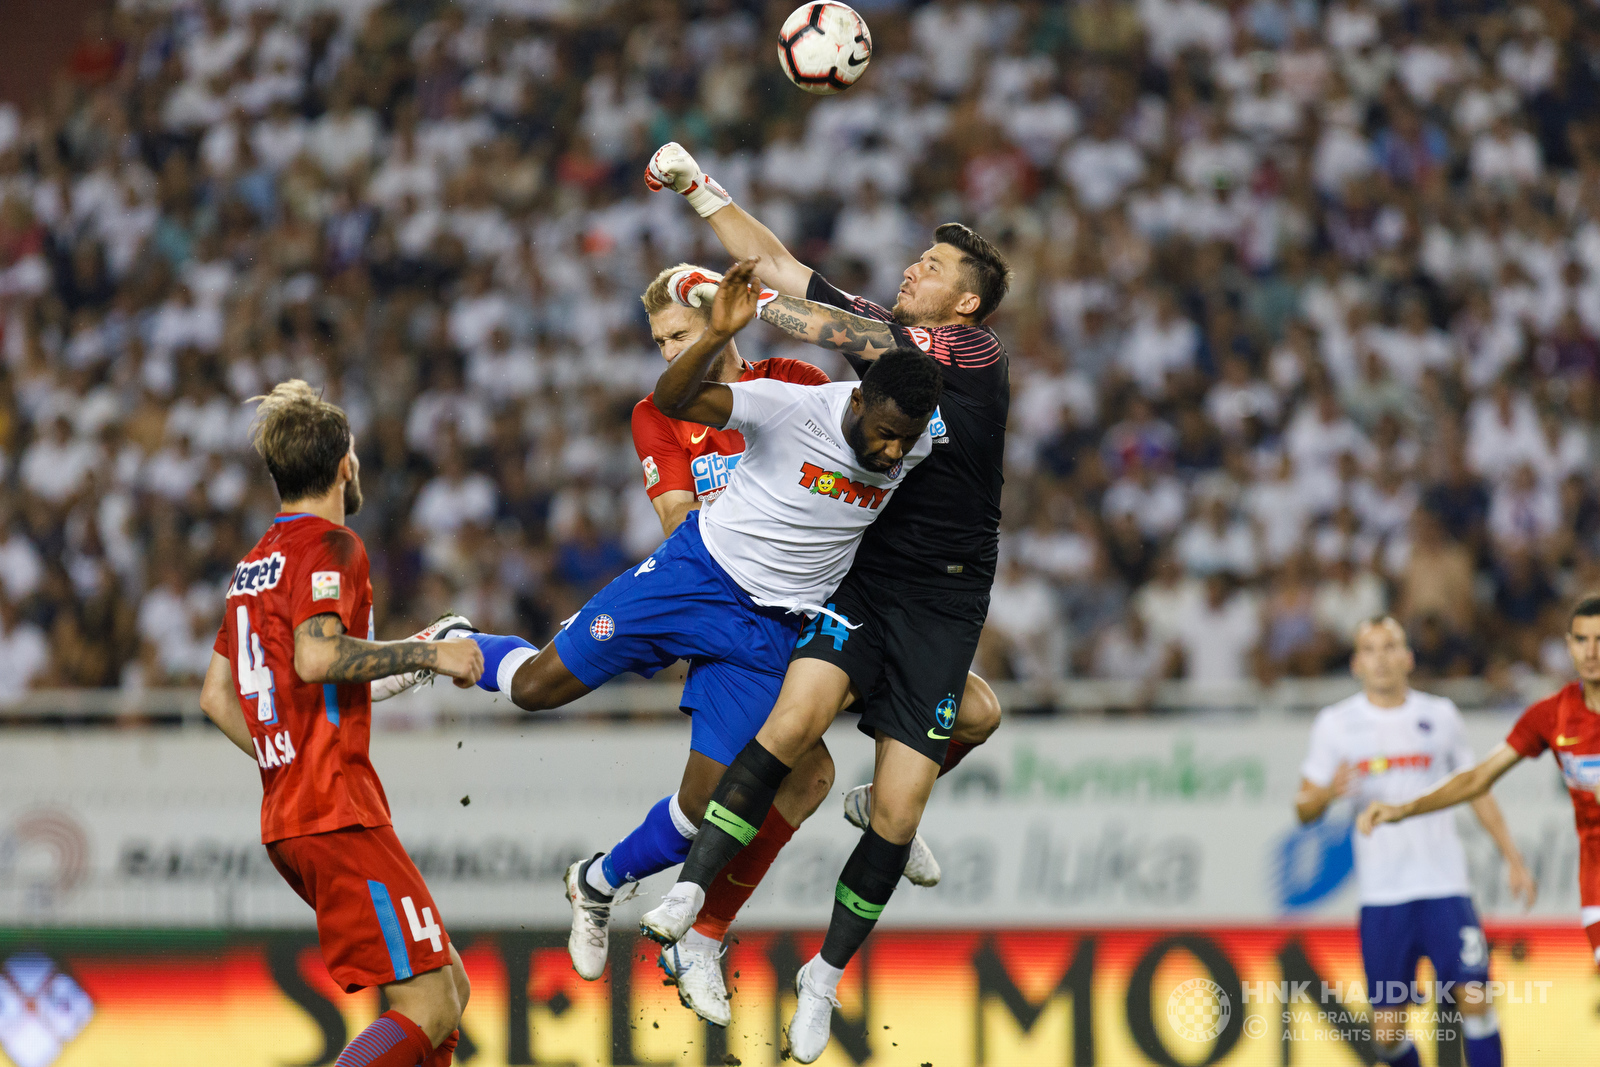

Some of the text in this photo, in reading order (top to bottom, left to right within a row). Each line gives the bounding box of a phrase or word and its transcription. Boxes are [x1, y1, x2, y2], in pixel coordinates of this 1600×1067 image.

[798, 461, 892, 510] TOMMY
[315, 588, 336, 598] LPF
[236, 605, 278, 725] 4
[401, 896, 443, 953] 4
